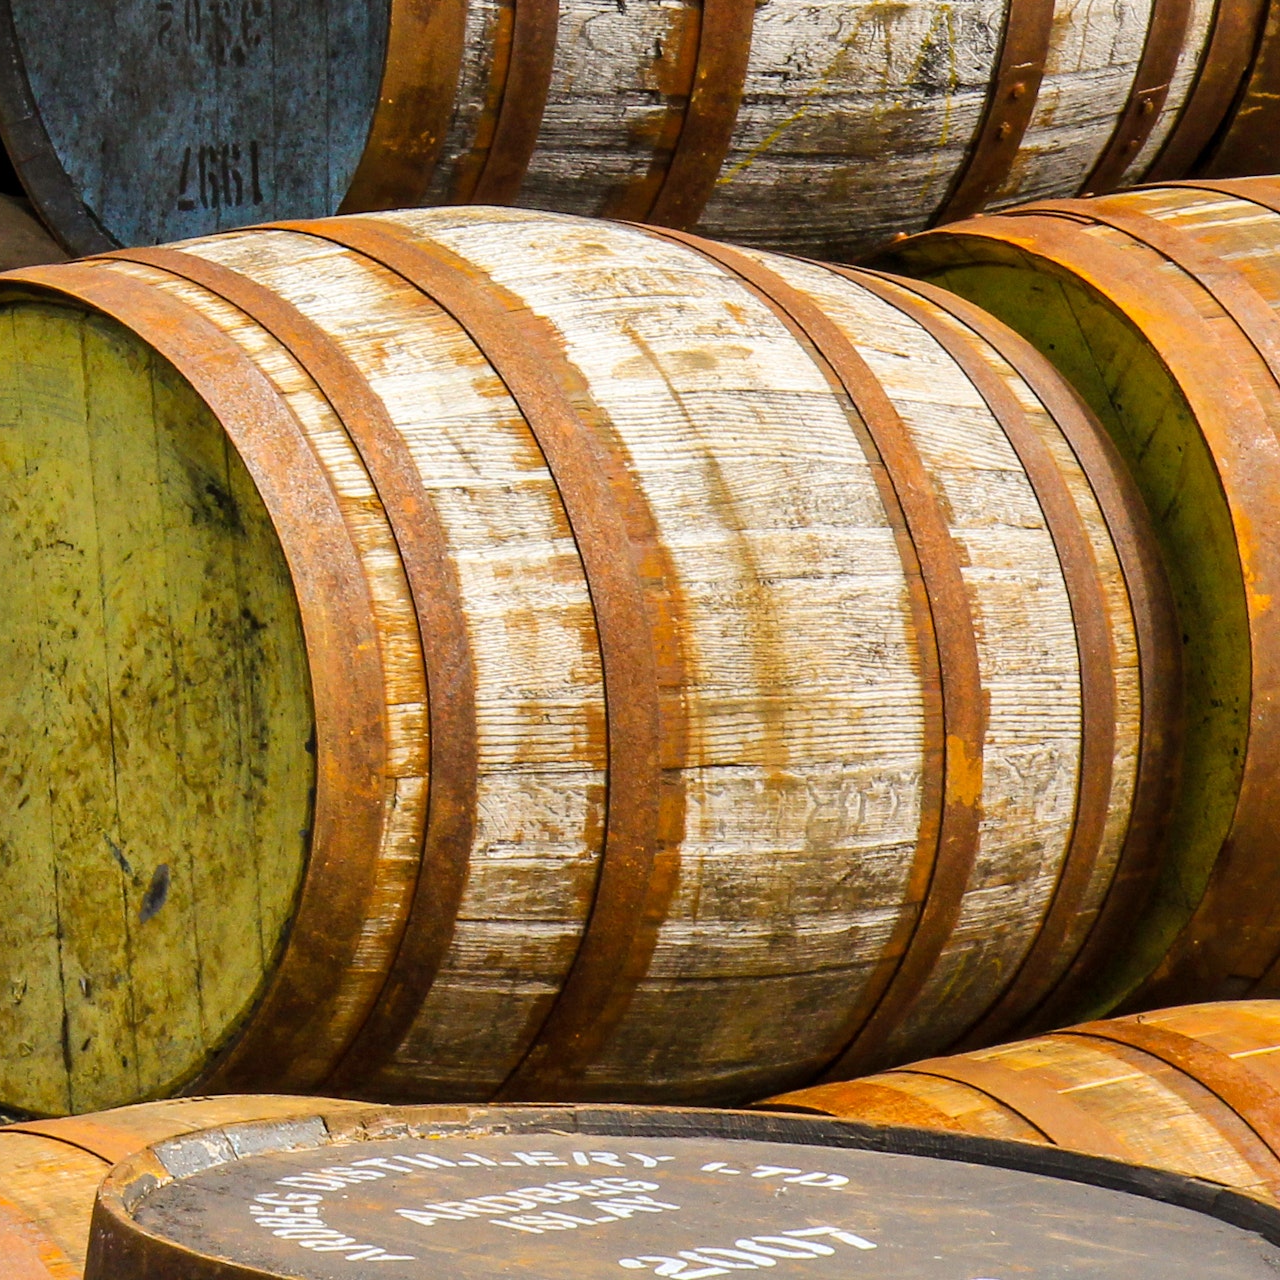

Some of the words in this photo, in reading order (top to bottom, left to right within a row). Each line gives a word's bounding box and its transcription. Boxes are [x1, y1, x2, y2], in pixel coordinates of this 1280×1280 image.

[176, 139, 264, 211] 1997
[275, 1151, 677, 1192] DISTILLERY
[249, 1192, 416, 1262] ARDBEG
[394, 1177, 659, 1226] ARDBEG
[490, 1195, 680, 1234] ISLAY
[619, 1226, 878, 1280] 2007
